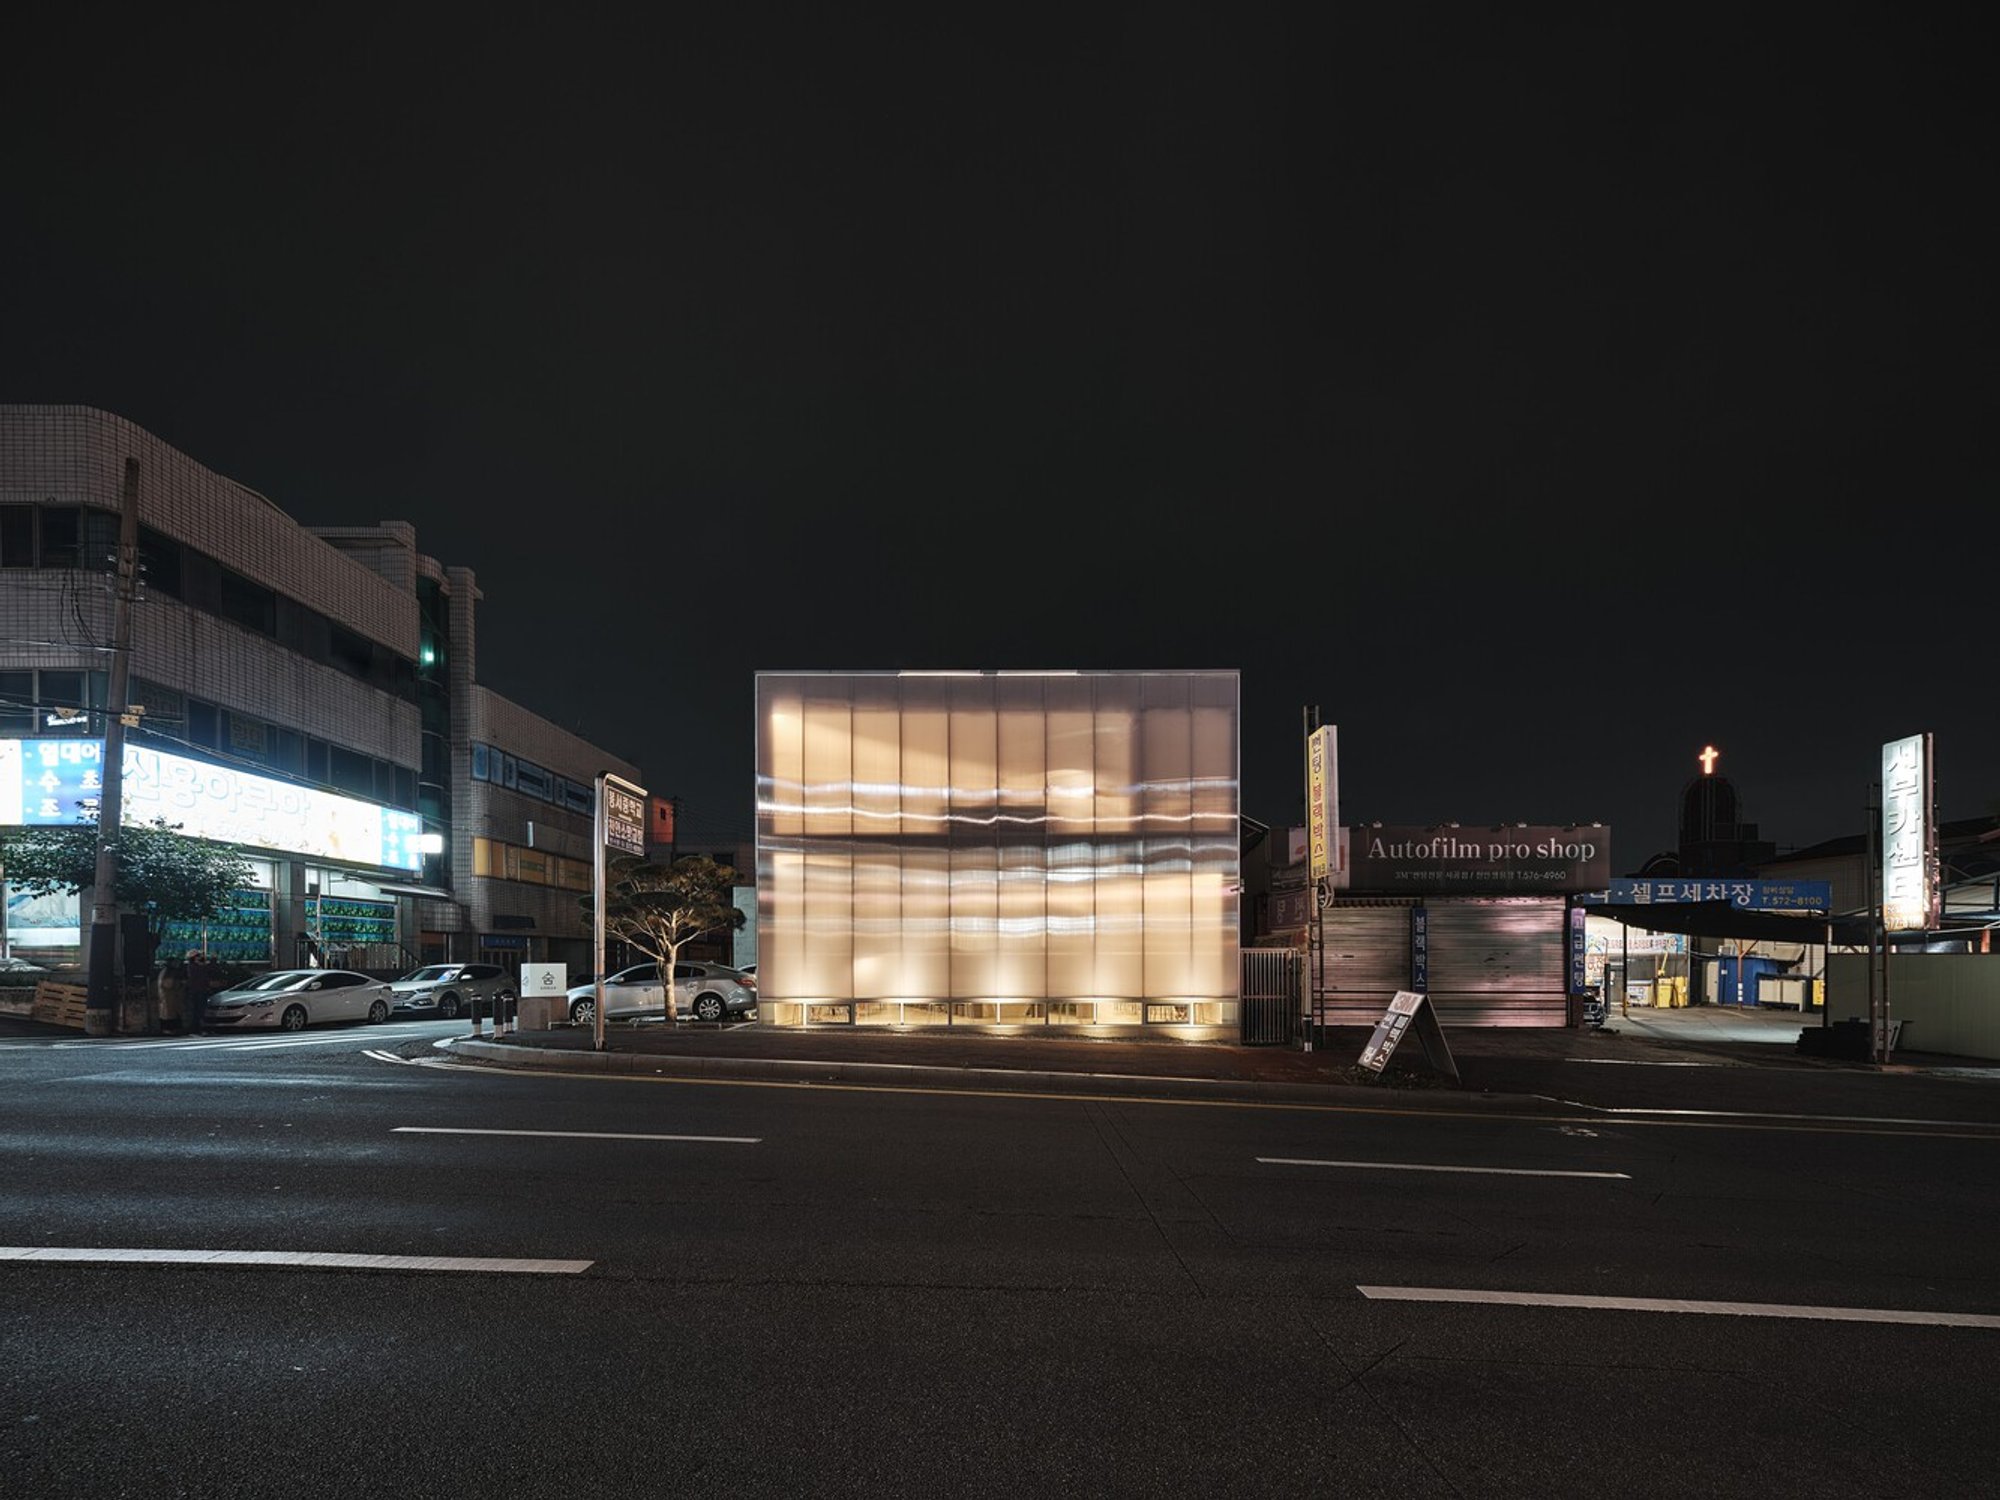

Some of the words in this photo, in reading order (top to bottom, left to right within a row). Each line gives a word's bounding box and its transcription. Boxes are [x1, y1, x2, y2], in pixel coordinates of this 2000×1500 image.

[39, 743, 100, 766] 열대어
[1368, 838, 1481, 859] Autofilm
[1488, 843, 1531, 862] pro
[1536, 837, 1595, 862] shop
